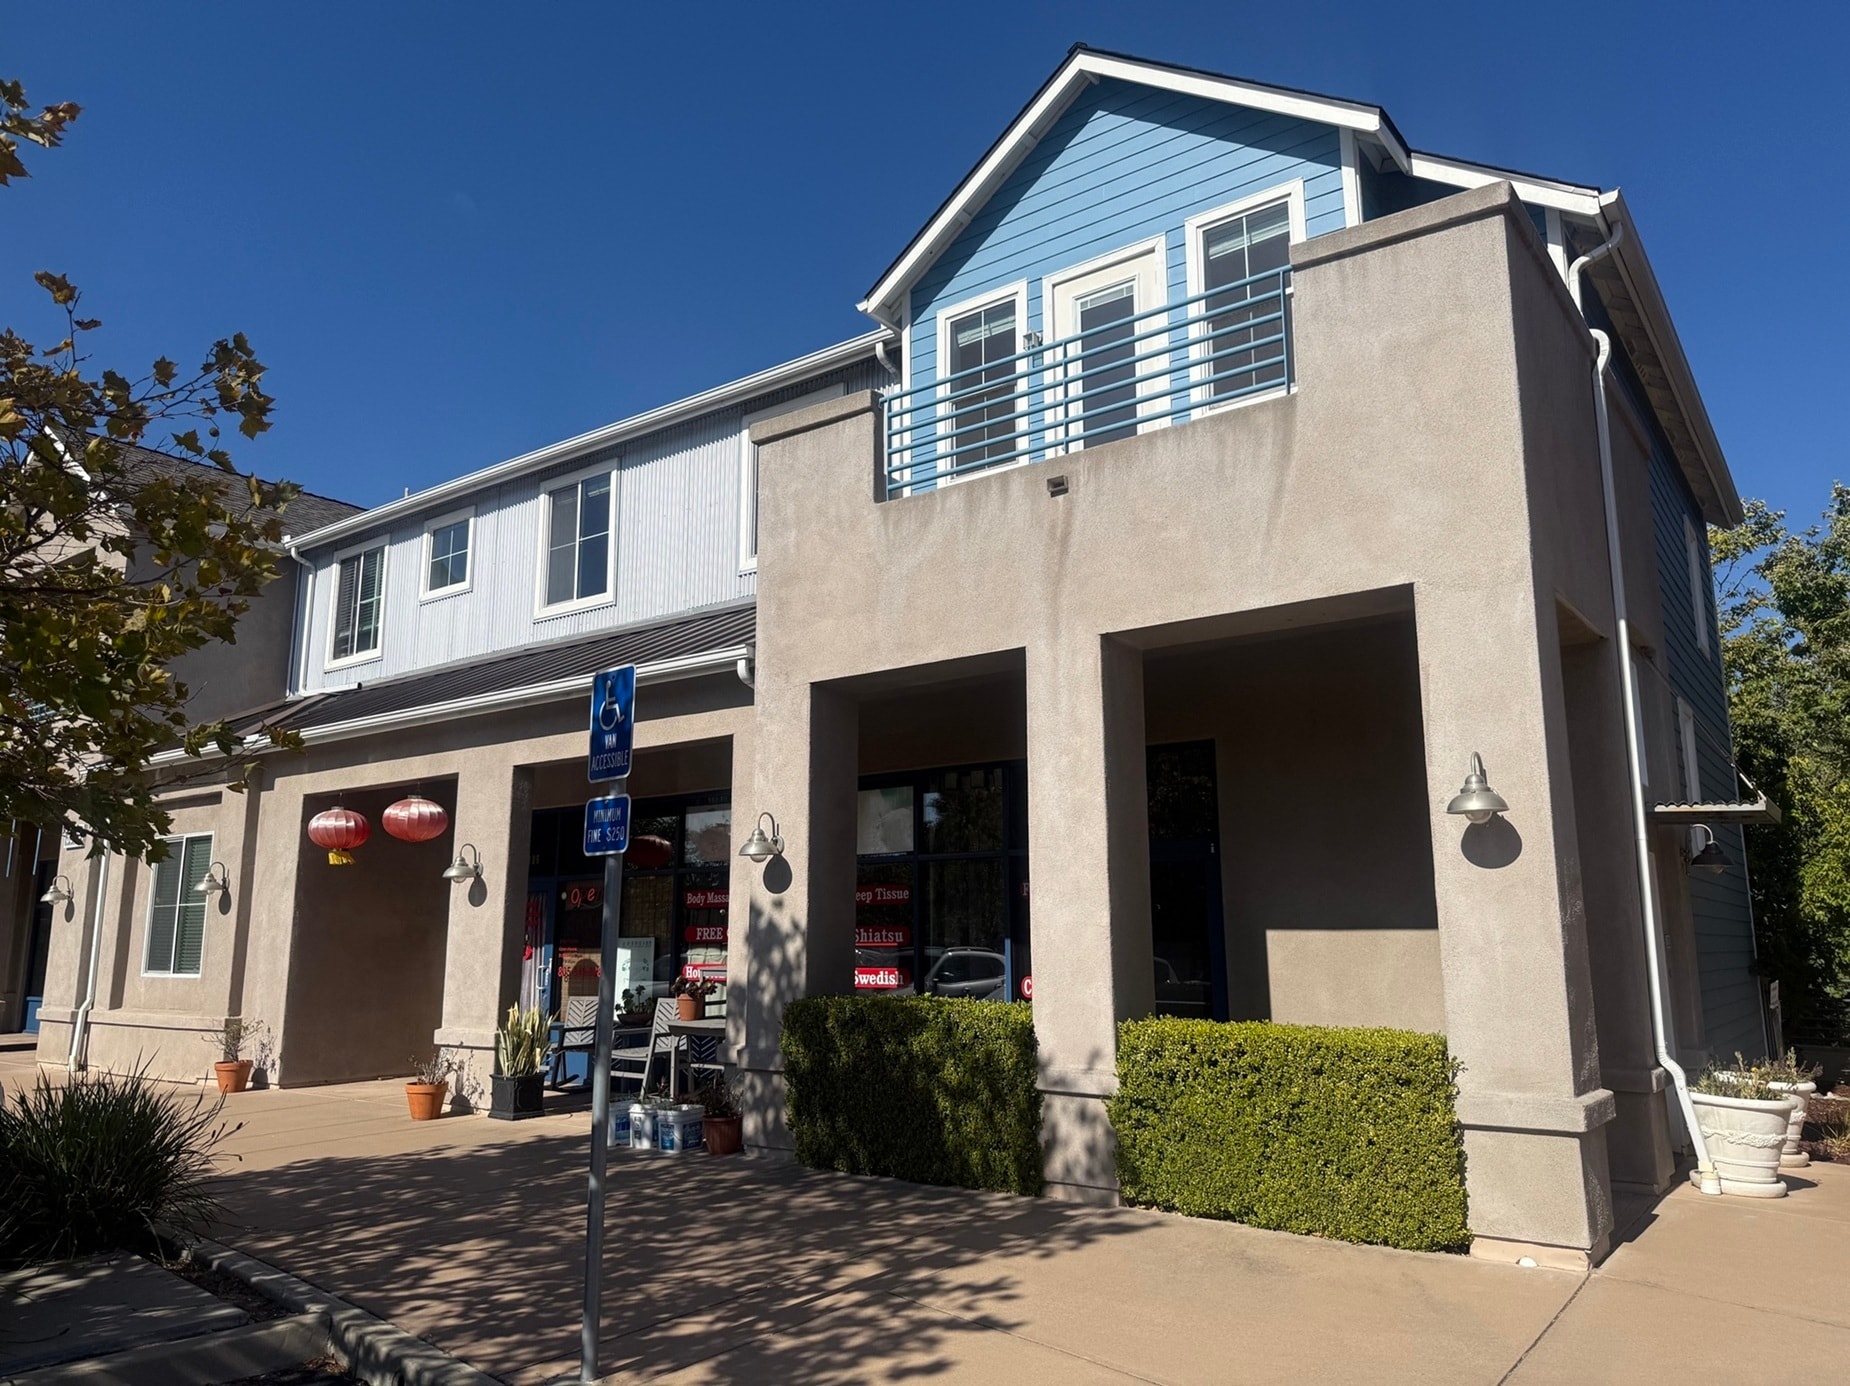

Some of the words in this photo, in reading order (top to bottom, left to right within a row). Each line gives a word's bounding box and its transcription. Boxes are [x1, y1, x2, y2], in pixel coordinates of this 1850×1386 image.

[604, 732, 617, 750] VAN
[591, 749, 628, 772] ACCESSIBLE
[593, 807, 621, 824] MINIMUM
[587, 828, 602, 843] FINE
[606, 826, 625, 842] $250
[687, 893, 705, 906] Body
[874, 888, 909, 900] Tissue
[696, 927, 723, 940] FREE
